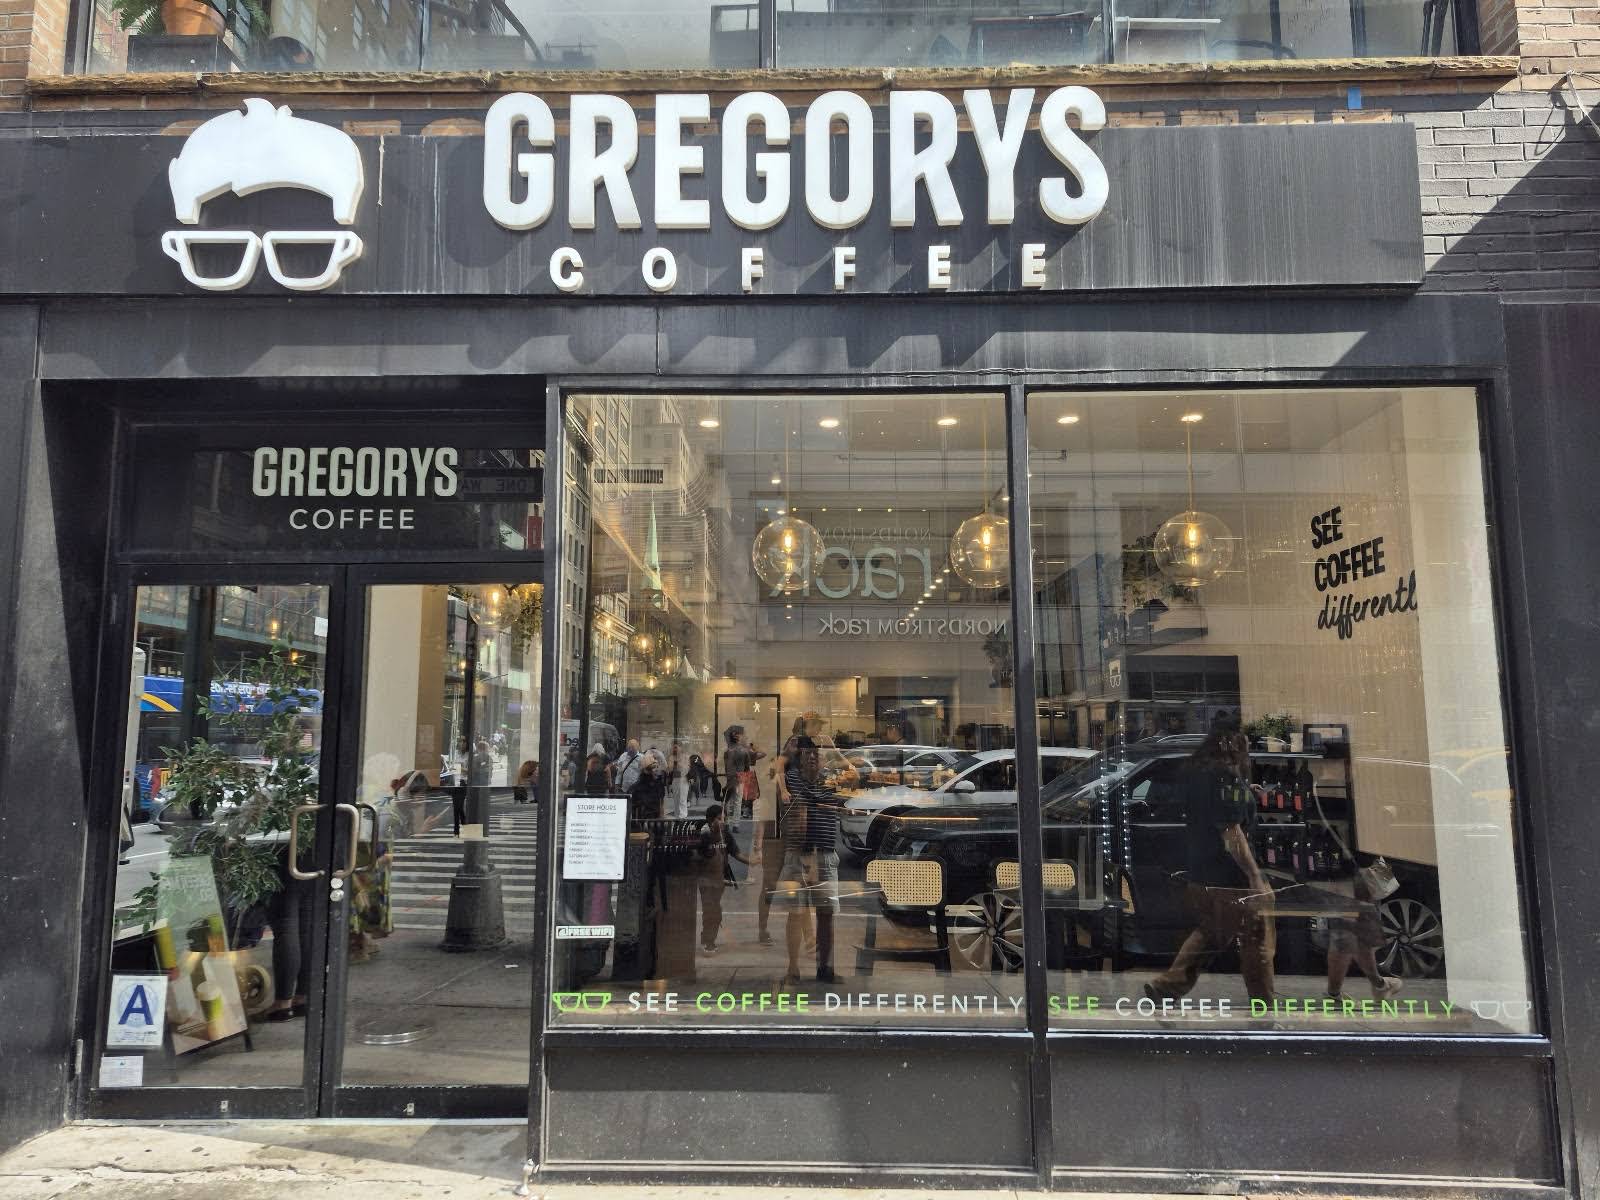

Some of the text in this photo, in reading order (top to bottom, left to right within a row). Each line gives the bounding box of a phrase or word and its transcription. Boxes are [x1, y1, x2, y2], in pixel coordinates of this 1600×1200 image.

[483, 86, 1110, 231] GREGORYS
[549, 242, 1049, 293] COFFEE
[252, 446, 458, 497] GREGORYS
[289, 508, 416, 530] COFFEE
[1310, 506, 1344, 549] SEE
[1314, 536, 1386, 592] COFFEE
[1317, 569, 1418, 640] differentl
[118, 984, 154, 1025] A
[628, 991, 1026, 1015] SEE COFFEE DIFFERENTLY
[1048, 995, 1456, 1019] SEE COFFEE DIFFERENTLY
